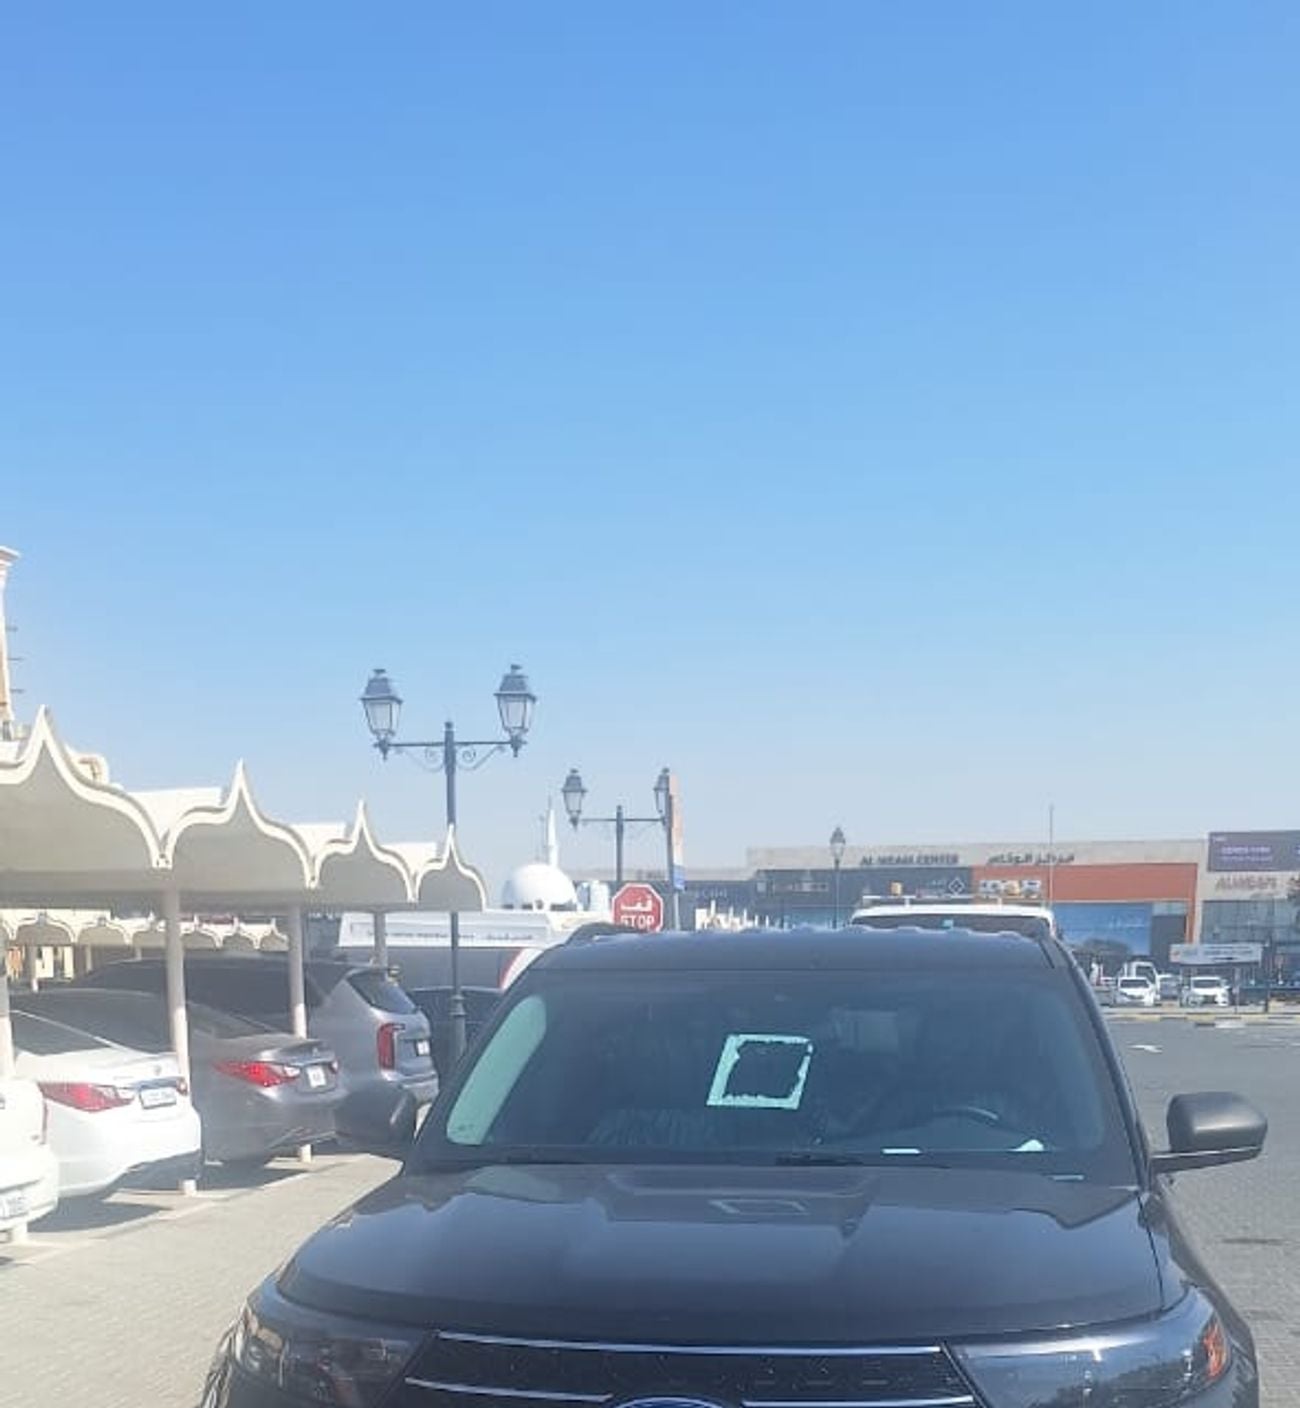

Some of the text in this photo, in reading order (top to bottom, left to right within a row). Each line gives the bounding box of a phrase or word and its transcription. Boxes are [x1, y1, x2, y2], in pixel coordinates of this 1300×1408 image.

[916, 853, 959, 864] CENTER
[620, 894, 652, 912] قف
[620, 915, 655, 931] STOP
